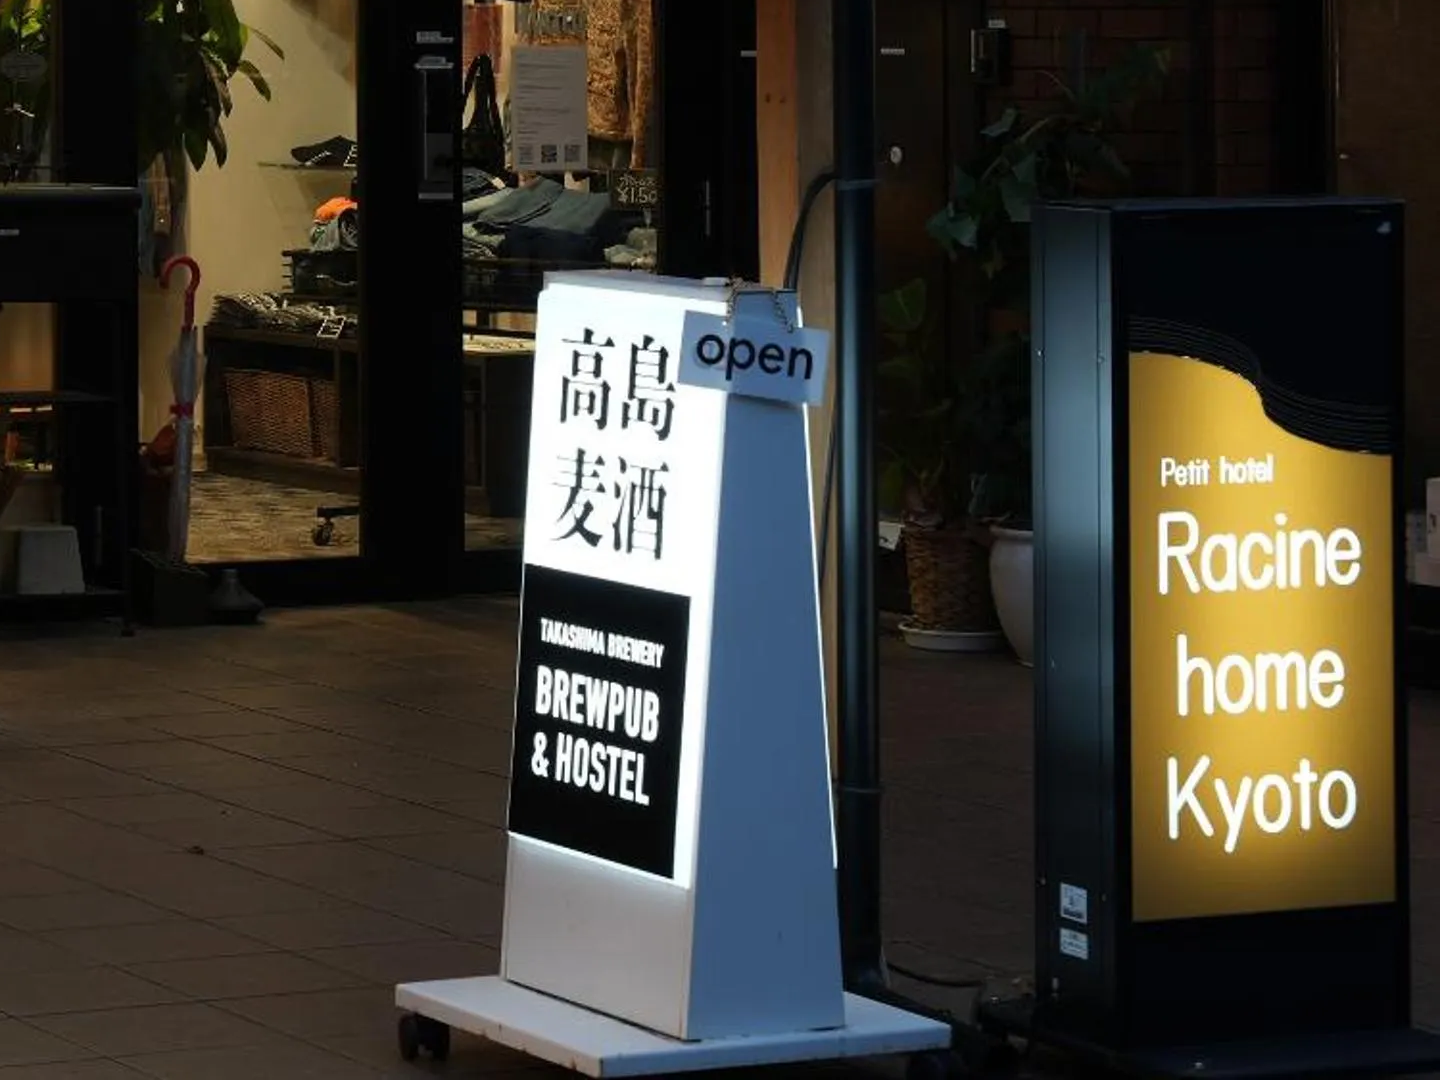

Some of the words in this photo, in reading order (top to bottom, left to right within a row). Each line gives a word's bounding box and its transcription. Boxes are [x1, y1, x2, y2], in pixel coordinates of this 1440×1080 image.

[695, 332, 814, 382] open
[1160, 457, 1210, 487] Petit
[1219, 454, 1274, 485] hotel
[1157, 510, 1362, 595] Racine
[540, 617, 606, 657] TAKASHIMA
[607, 632, 665, 669] BREWERY
[1176, 634, 1345, 717] home
[535, 664, 660, 742] BREWPUB
[531, 731, 550, 778] &
[555, 731, 650, 807] HOSTEL
[1166, 755, 1357, 854] Kyoto
